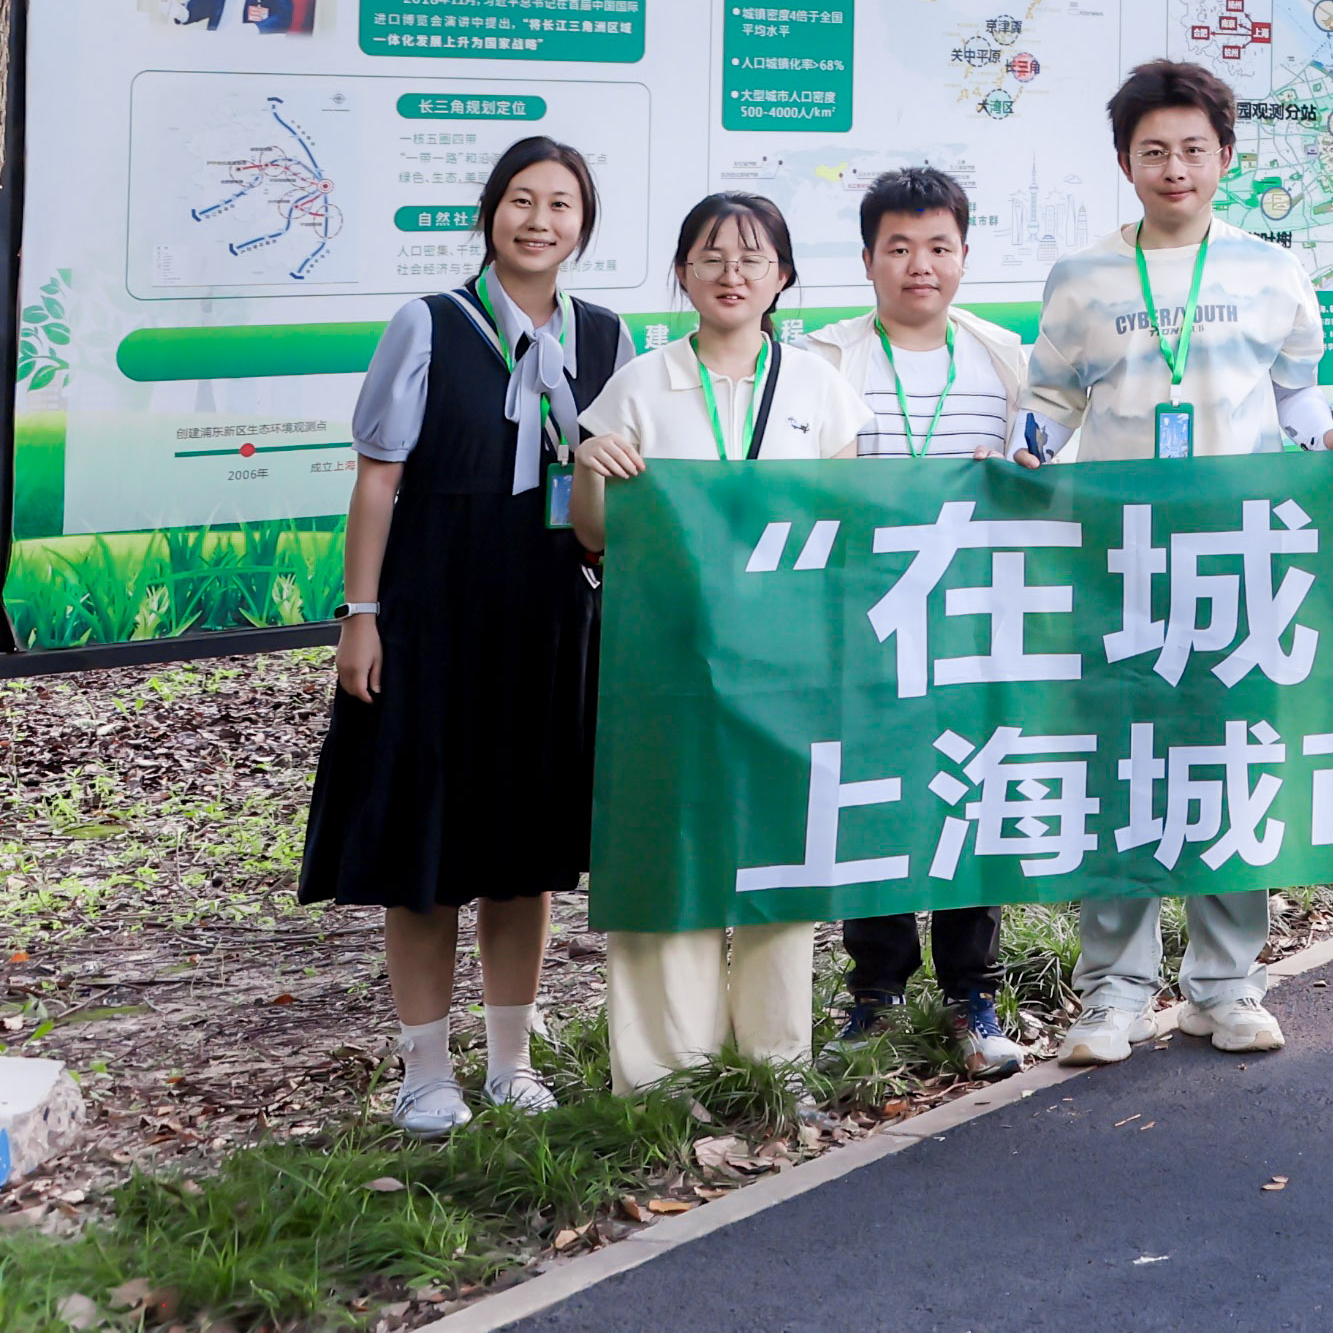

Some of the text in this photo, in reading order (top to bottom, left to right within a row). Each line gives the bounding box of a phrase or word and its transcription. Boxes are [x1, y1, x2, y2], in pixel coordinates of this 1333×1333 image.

[742, 23, 790, 37] 平均水平
[951, 48, 1001, 64] 关中平原
[740, 89, 836, 104] 大型城市人口密度
[418, 99, 527, 116] 长三角规划定位
[977, 99, 1014, 114] 大湾区
[1236, 102, 1317, 121] 园观测分站
[644, 324, 670, 349] 建
[176, 420, 328, 440] 创建浦东新区生态环境观测点
[227, 468, 269, 482] 2006年
